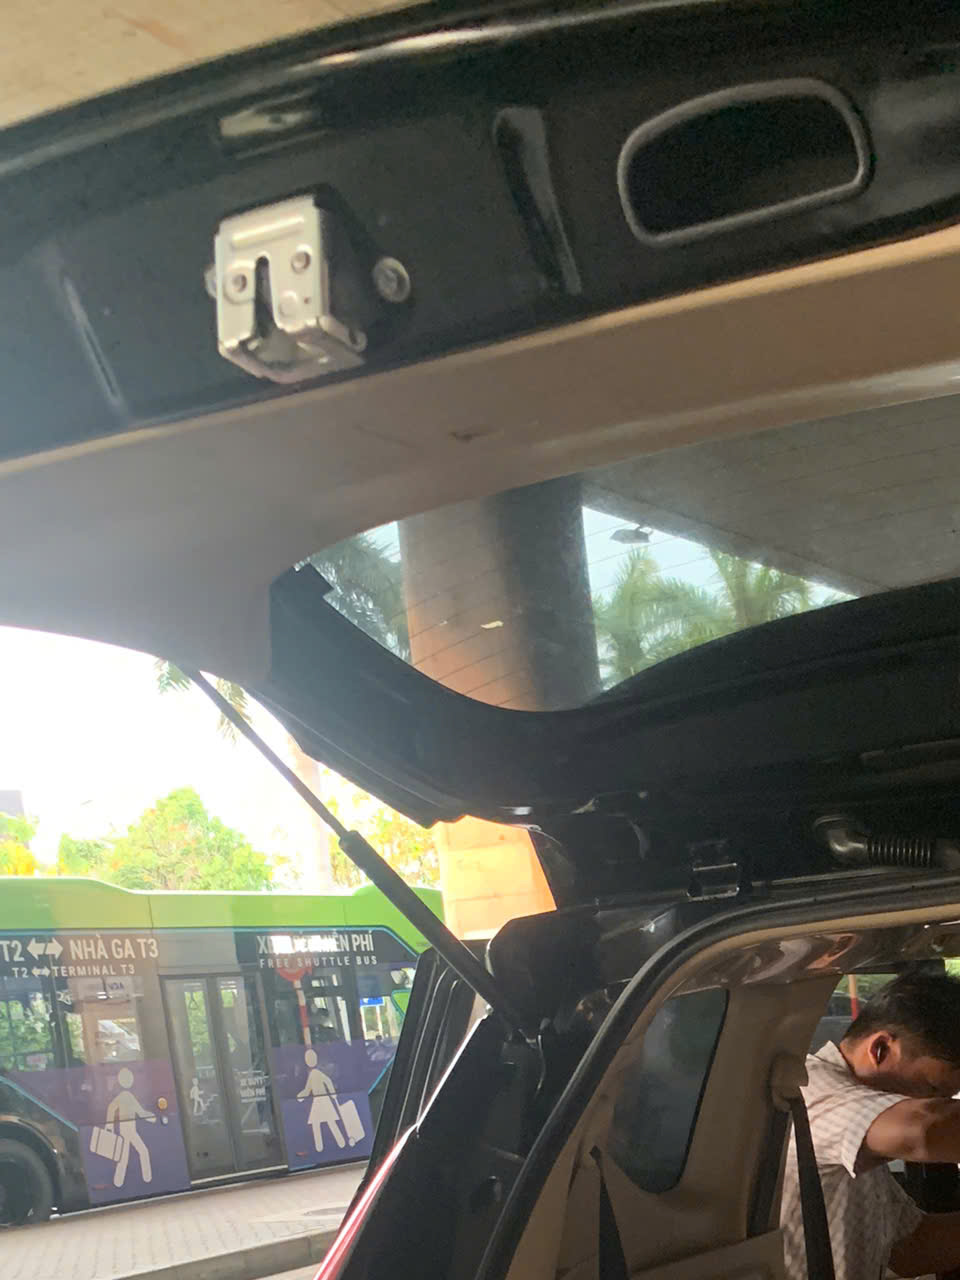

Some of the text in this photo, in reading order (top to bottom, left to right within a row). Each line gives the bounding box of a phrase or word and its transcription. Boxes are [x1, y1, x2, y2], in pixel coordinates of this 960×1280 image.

[0, 933, 160, 962] T2 NHÀ GA T3
[351, 930, 375, 952] PHÍ
[11, 964, 136, 978] T2 TERMINAL T3
[260, 955, 378, 969] FREE SHUTTLE BUS
